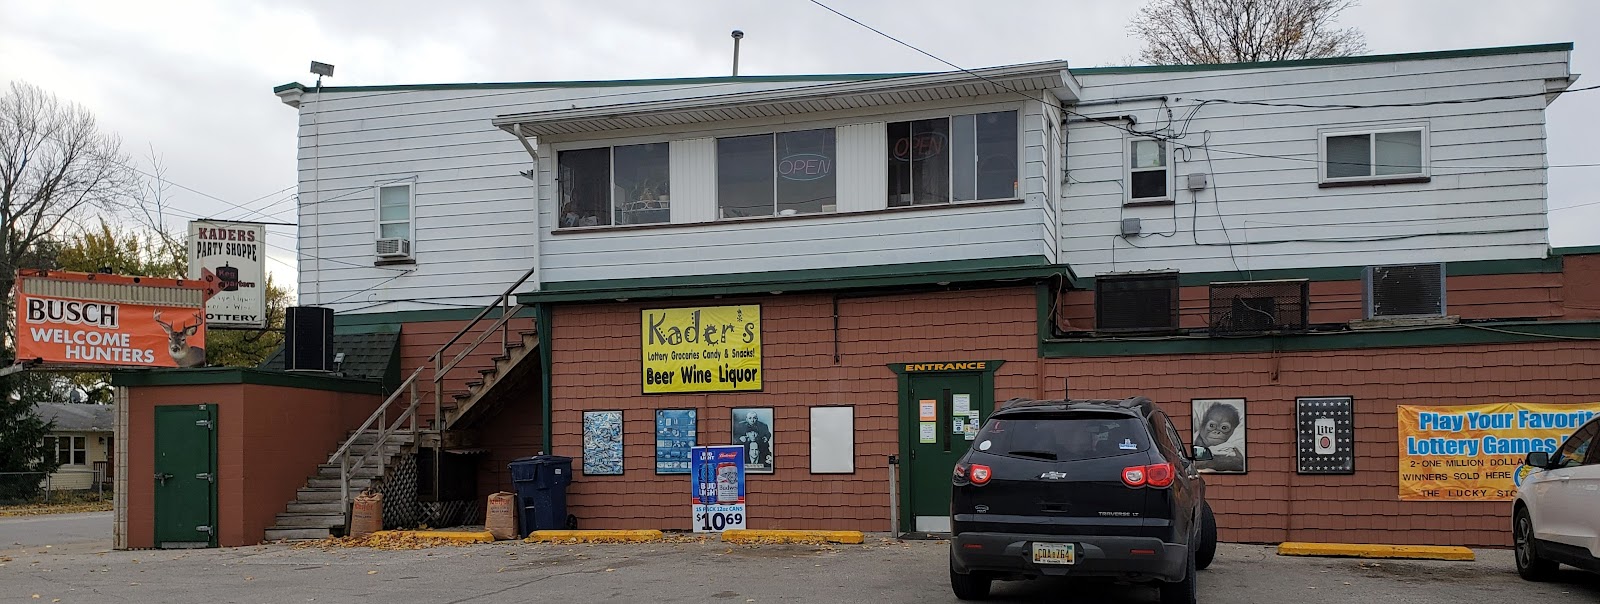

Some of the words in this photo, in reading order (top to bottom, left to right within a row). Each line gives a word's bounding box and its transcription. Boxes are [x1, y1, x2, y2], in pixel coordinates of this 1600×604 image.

[895, 137, 943, 157] OPEN
[779, 160, 831, 174] OPEN
[199, 228, 255, 242] KADERS
[197, 242, 223, 259] PARTY
[226, 242, 257, 262] SHOPPE
[27, 298, 119, 328] BUSCH
[205, 313, 257, 322] OTTERY
[649, 309, 754, 346] Kader's
[30, 328, 130, 347] WELCOME
[65, 346, 154, 363] HUNTERS
[648, 352, 668, 363] Lottery
[672, 350, 699, 360] Groceries
[703, 349, 721, 361] Candy
[724, 349, 729, 358] &
[732, 348, 755, 358] Snacks!
[905, 362, 986, 371] ENTRANCE
[646, 368, 674, 385] Beer
[681, 364, 712, 384] Wine
[719, 363, 758, 388] Liquor
[1420, 412, 1463, 431] Play
[1467, 411, 1514, 430] Your
[1518, 410, 1594, 429] Favorit
[1317, 426, 1333, 436] Lite
[1408, 437, 1480, 456] Lottery
[1483, 435, 1558, 455] Games
[1446, 459, 1484, 467] MILLION
[1490, 458, 1526, 466] DOLLA
[1403, 473, 1448, 481] WINNERS
[1453, 472, 1480, 480] SOLD
[1486, 472, 1511, 480] HERE
[1448, 489, 1487, 497] LUCKY
